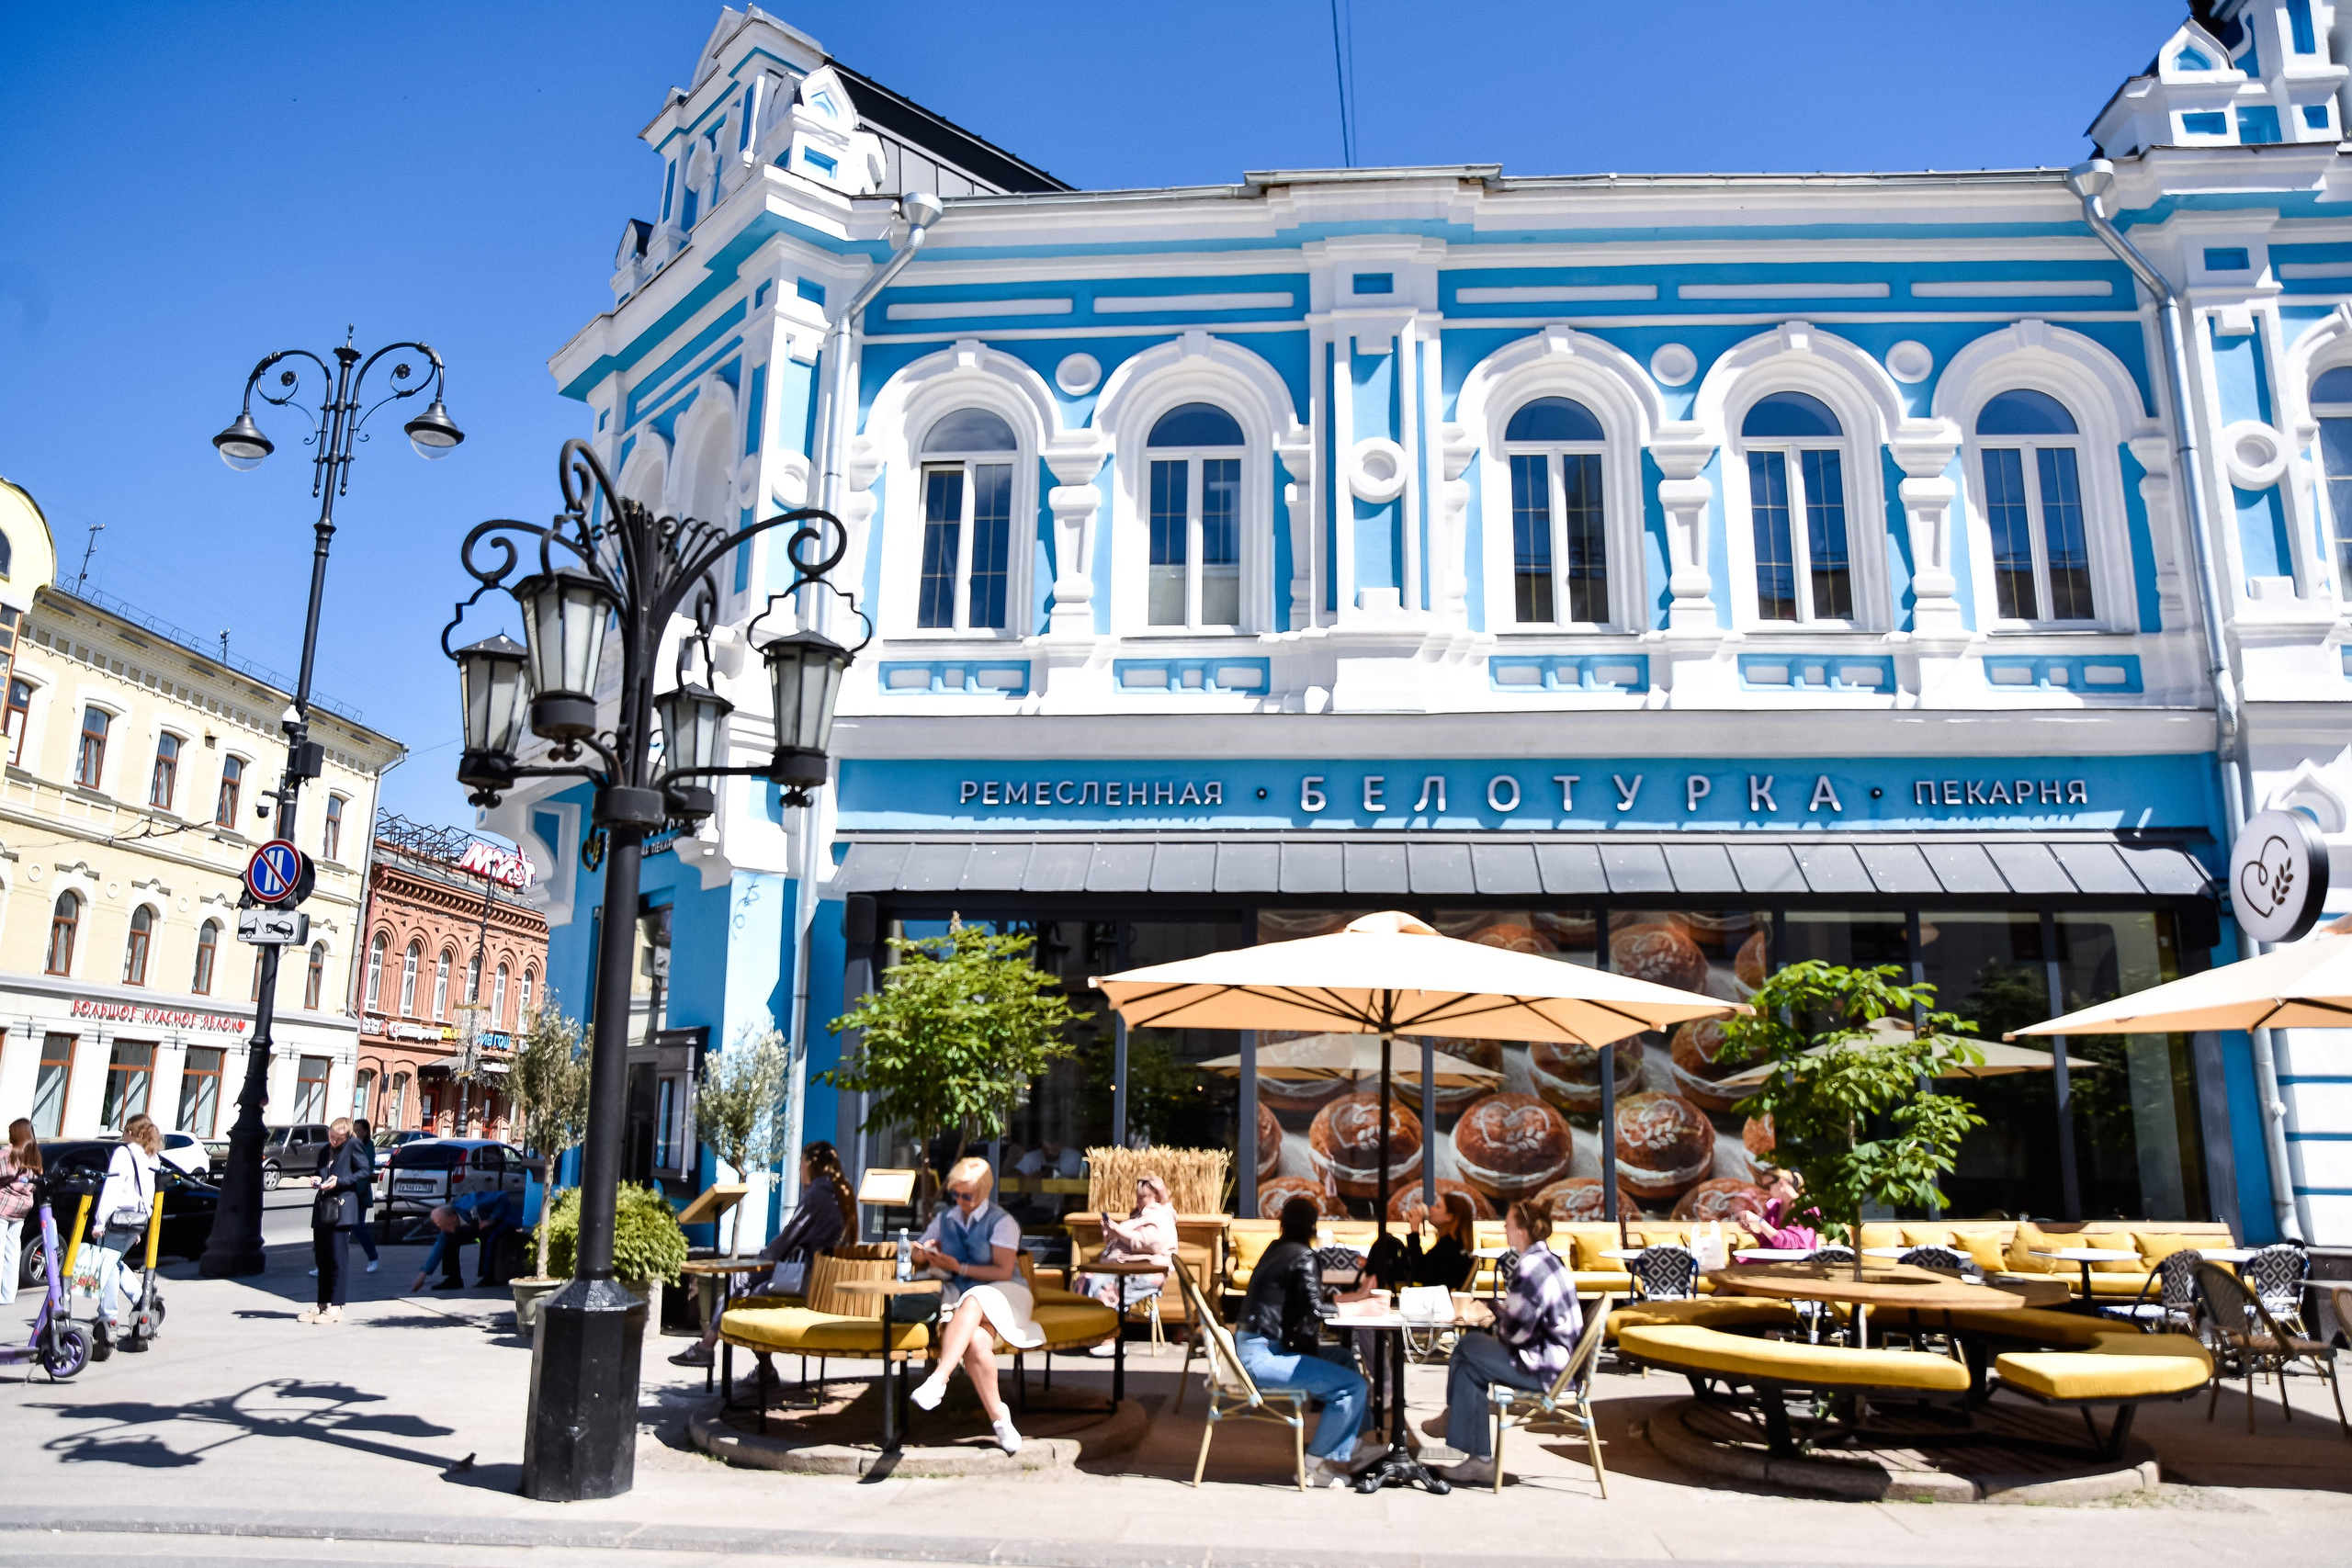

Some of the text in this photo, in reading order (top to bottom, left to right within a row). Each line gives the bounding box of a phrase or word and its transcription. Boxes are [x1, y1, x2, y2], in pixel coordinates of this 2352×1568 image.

[959, 774, 2088, 813] РЕМЕСЛЕННАЯ БЕЛОТУРКА ПЕКАРНЯ
[650, 837, 679, 855] ПЕКАР
[73, 999, 137, 1020] БОЛЬШОЕ
[143, 1007, 198, 1026] КРАСНОЕ
